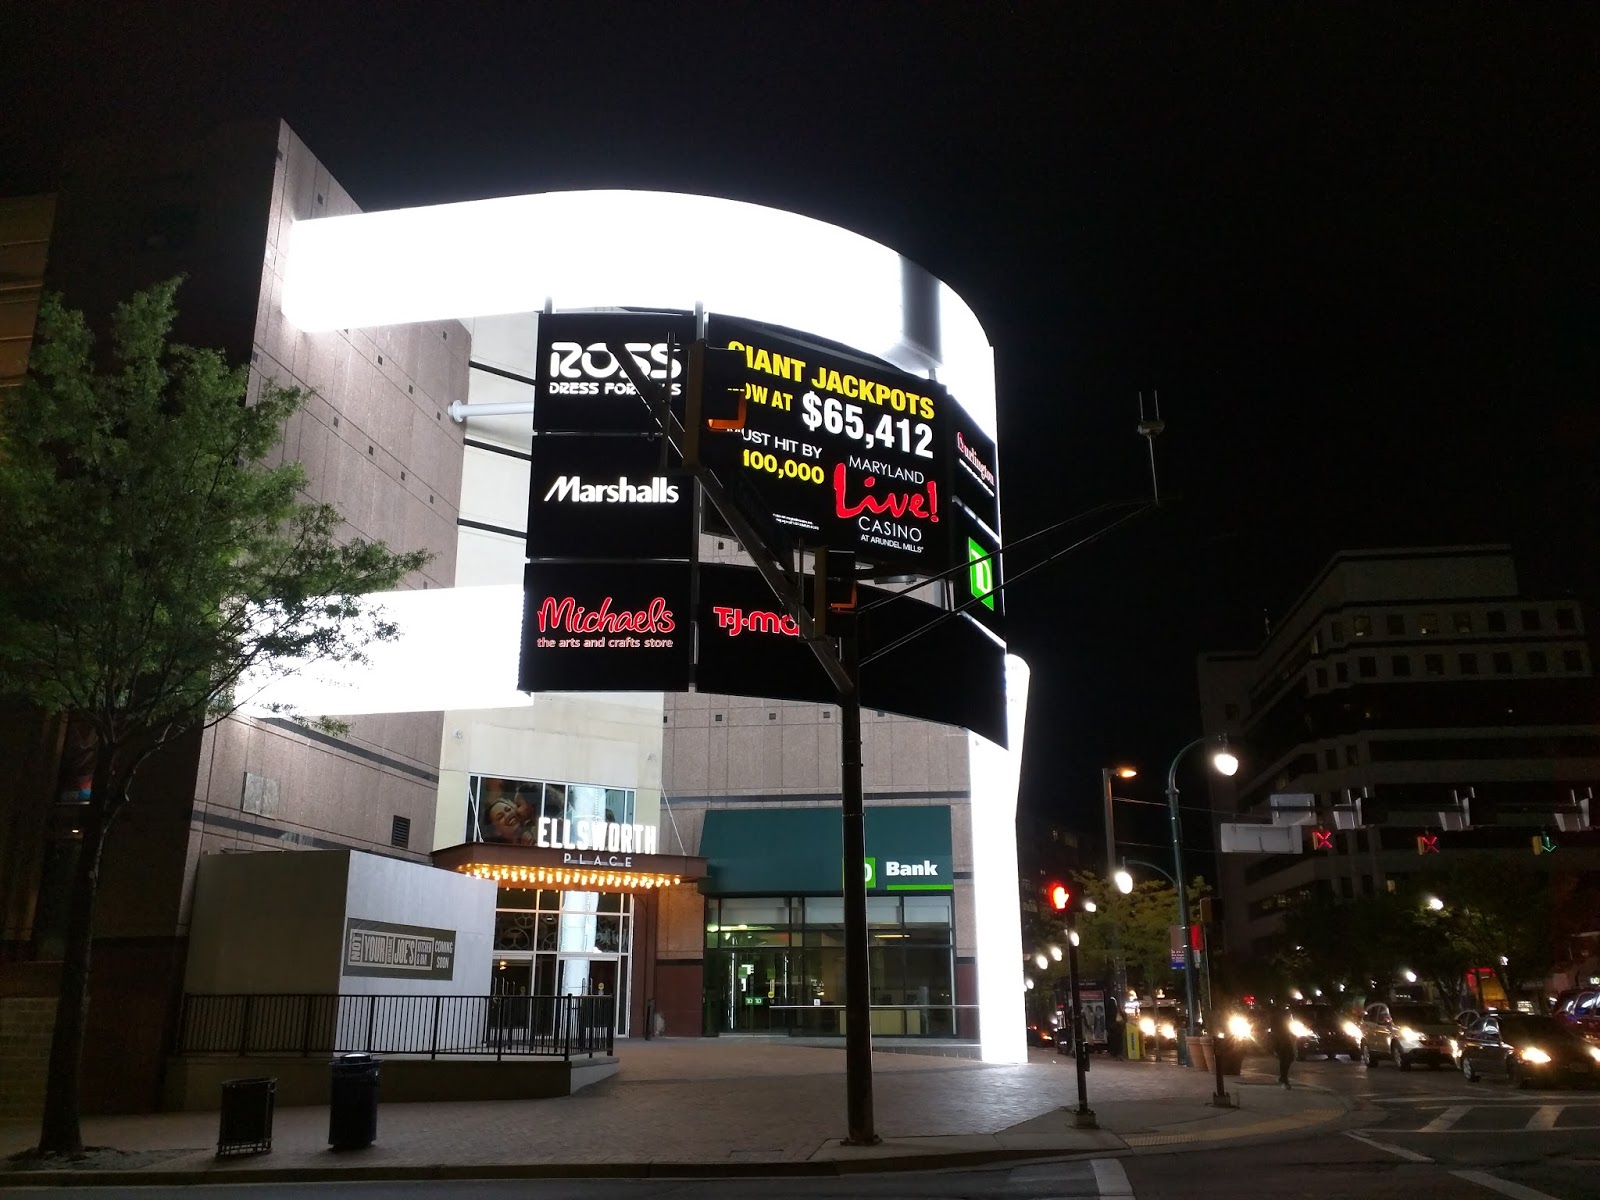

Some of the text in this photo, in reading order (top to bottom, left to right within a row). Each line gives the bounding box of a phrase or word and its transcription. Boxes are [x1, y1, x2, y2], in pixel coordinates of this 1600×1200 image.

[549, 383, 636, 395] DRESS FOR
[771, 390, 793, 411] AT
[811, 367, 935, 419] JACKPOTS
[802, 391, 934, 459] $65,412
[727, 427, 822, 459] UST HIT BY
[848, 455, 925, 484] MARYLAND
[957, 431, 995, 486] Burlington
[544, 475, 680, 503] Marshalls
[833, 462, 939, 523] Live!
[858, 516, 922, 542] CASINO
[860, 534, 870, 542] AT
[870, 536, 902, 549] ARUNDEL
[537, 597, 675, 633] Michaels
[537, 637, 674, 648] the arts and crafts store
[537, 817, 656, 855] ELLSWORTH
[563, 853, 632, 868] PLACE
[886, 860, 938, 876] Bank
[351, 933, 361, 961] NOT
[364, 936, 386, 962] YOUR
[394, 939, 415, 964] JOE'S
[434, 940, 453, 953] COMING
[436, 956, 449, 969] SOON
